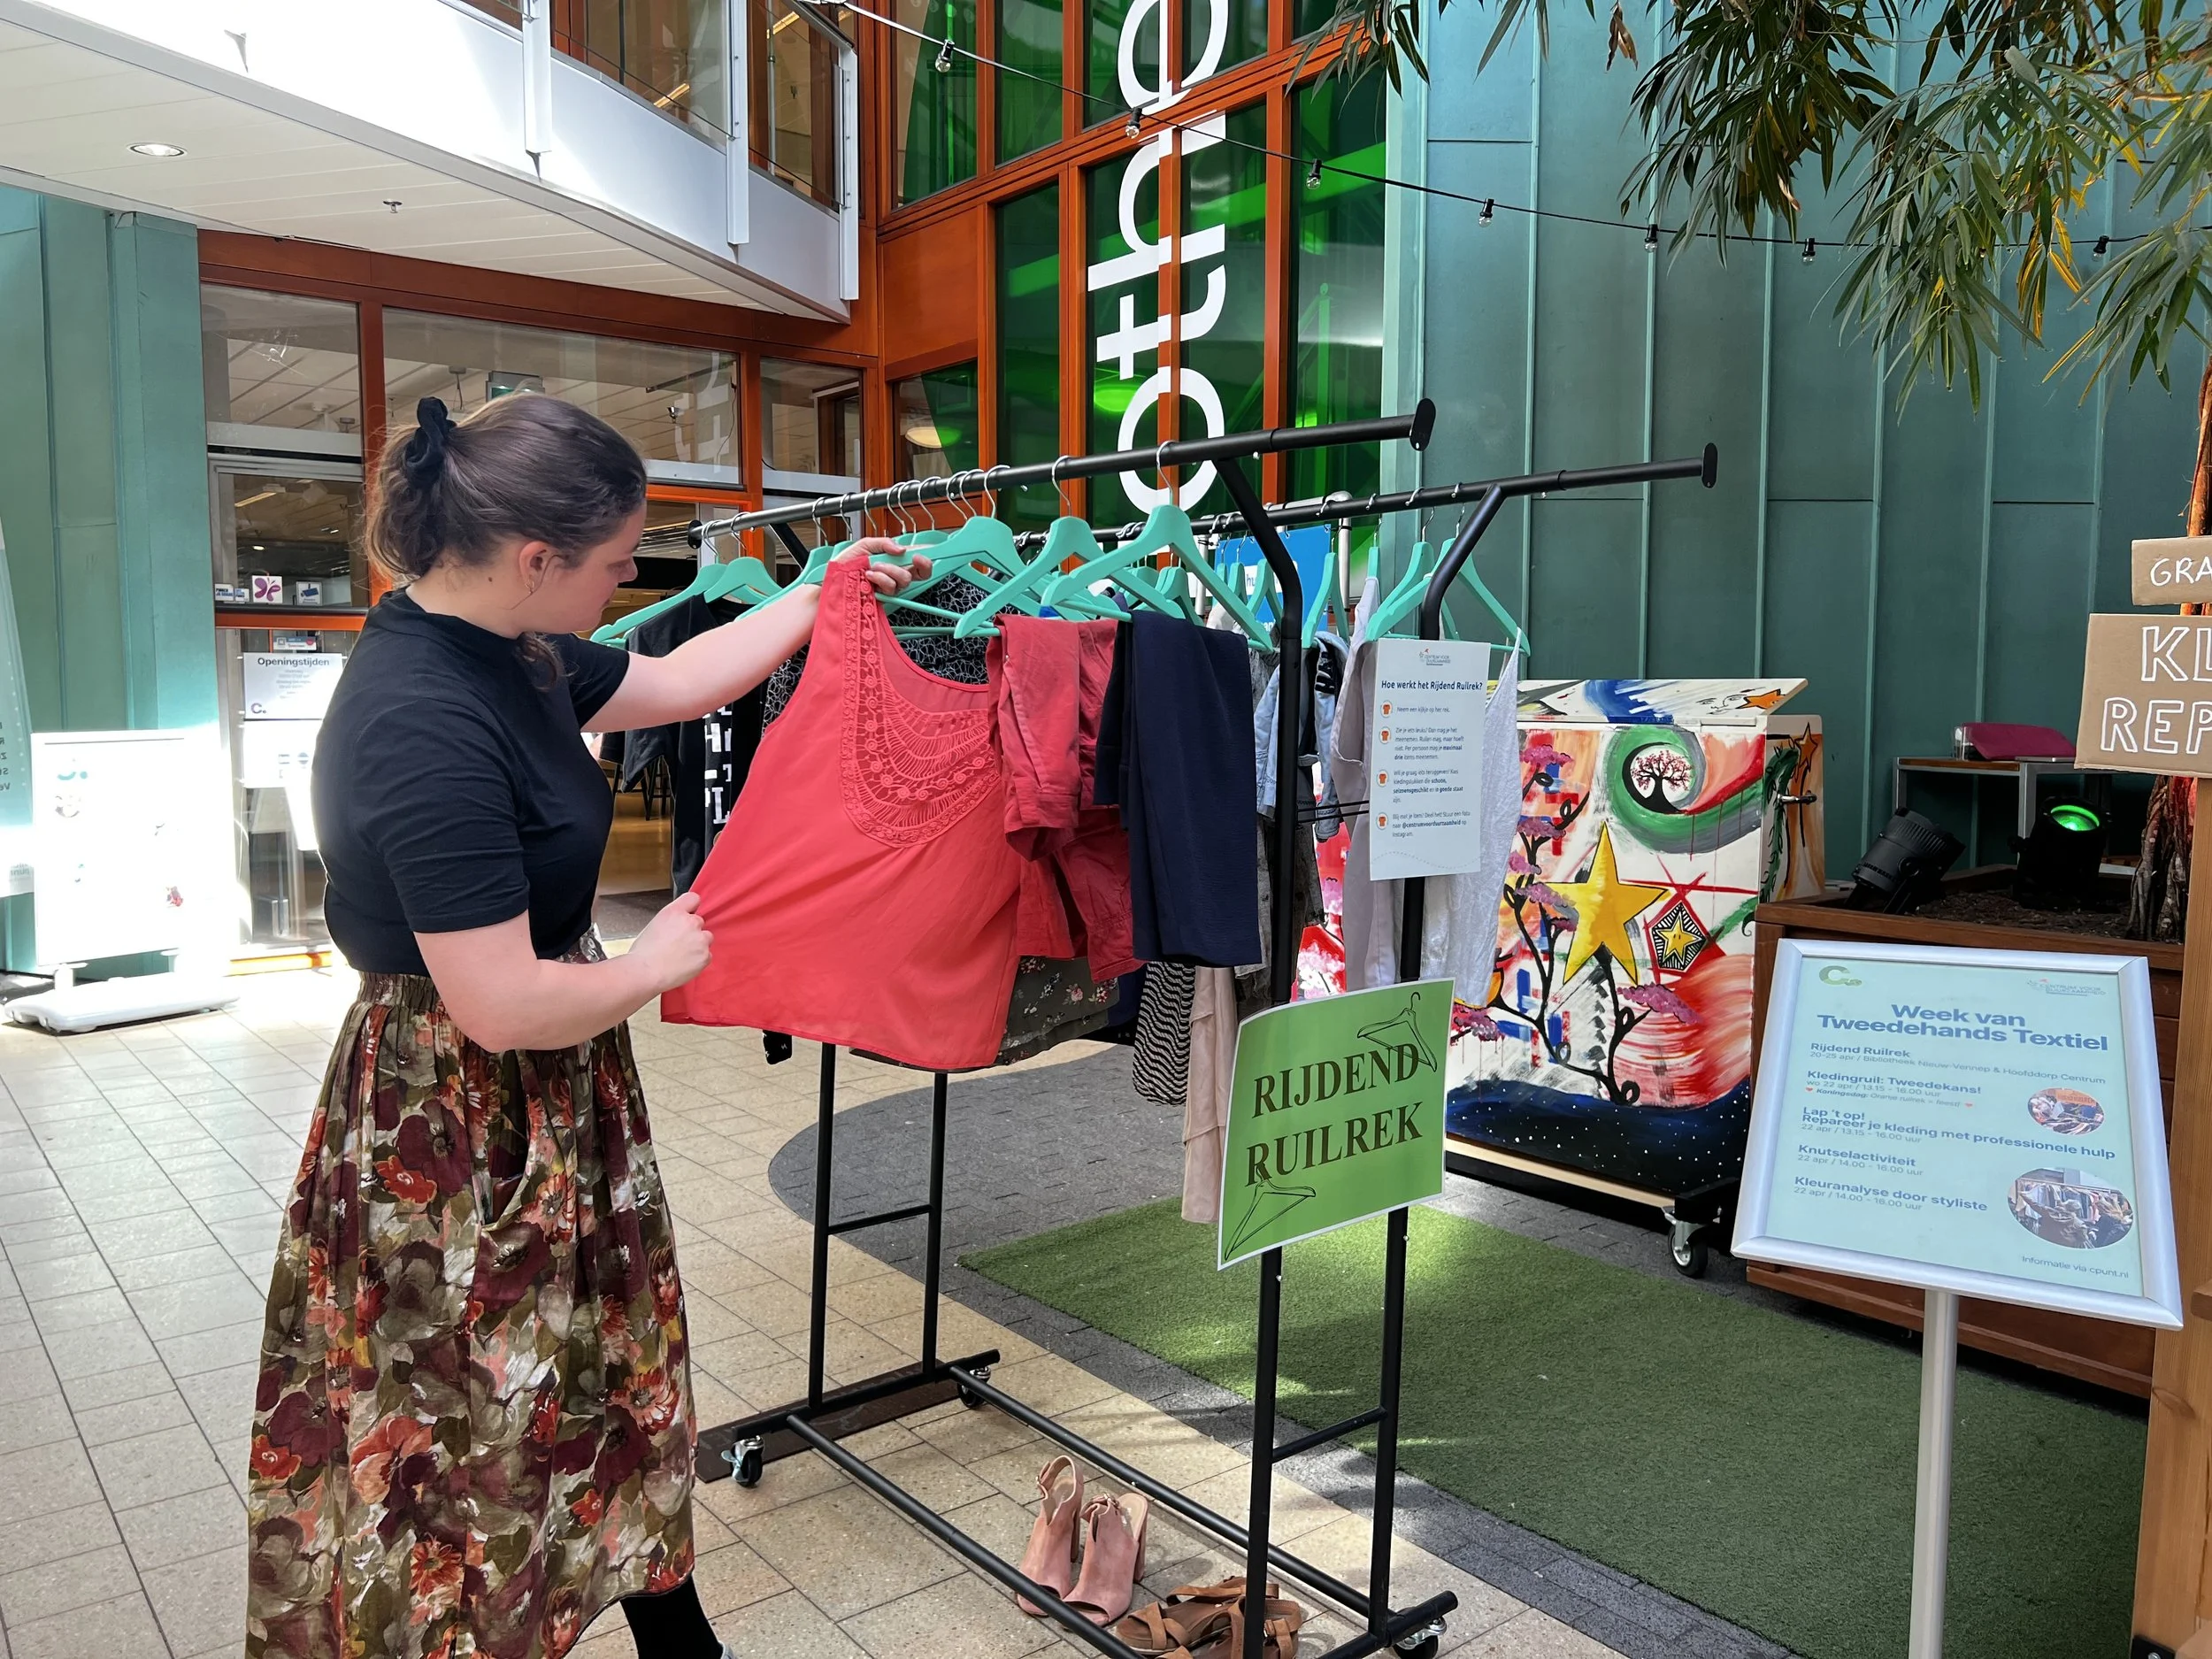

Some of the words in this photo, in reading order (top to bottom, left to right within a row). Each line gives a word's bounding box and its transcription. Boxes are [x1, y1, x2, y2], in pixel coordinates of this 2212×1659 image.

[257, 657, 329, 667] Openingstijden
[1381, 680, 1394, 689] Hoe
[1397, 680, 1417, 689] werkt
[1417, 680, 1428, 689] het
[1431, 681, 1455, 691] Rijdend
[1456, 681, 1482, 690] Ruilrek?
[1892, 1004, 1970, 1023] Week
[1976, 1013, 2025, 1026] van
[1816, 1015, 2007, 1041] Tweedehands
[2013, 1029, 2108, 1050] Textiel
[1811, 1043, 1860, 1054] Rijdend
[1863, 1047, 1910, 1057] Ruilrek
[1252, 1043, 1419, 1119] RIJDEND
[1863, 1056, 1916, 1065] Bibliotheek
[1918, 1060, 1991, 1072] Nieuw-Vennep
[2003, 1068, 2058, 1079] Hoofddorp
[2061, 1073, 2106, 1084] Centrum
[1808, 1071, 1884, 1085] Kledingruil:
[1888, 1077, 1981, 1094] Tweedekans!
[1816, 1088, 1868, 1098] Koningsdag:
[1897, 1087, 1922, 1095] 16.00
[1803, 1107, 1828, 1118] Lap
[1844, 1112, 1865, 1121] op!
[1245, 1102, 1423, 1187] RUILREK
[1802, 1114, 1866, 1128] Repareer
[1869, 1120, 1880, 1131] je
[1885, 1123, 1937, 1139] kleding
[1941, 1131, 1970, 1141] met
[1974, 1134, 2077, 1154] professionele
[2081, 1147, 2115, 1159] hulp
[1877, 1132, 1901, 1141] 16.00
[1799, 1144, 1916, 1166] Knutselactiviteit
[1839, 1159, 1865, 1168] 14.00
[1877, 1164, 1903, 1173] 16.00
[1794, 1176, 1889, 1197] Kleuranalyse
[1893, 1190, 1927, 1202] door
[1932, 1196, 1987, 1211] styliste
[1809, 1189, 1825, 1198] apr
[1836, 1193, 1863, 1202] 14.00
[1875, 1197, 1901, 1207] 16.00
[2023, 1256, 2070, 1269] Informatie
[2073, 1263, 2086, 1272] via
[2090, 1267, 2128, 1278] cpunt.nl
